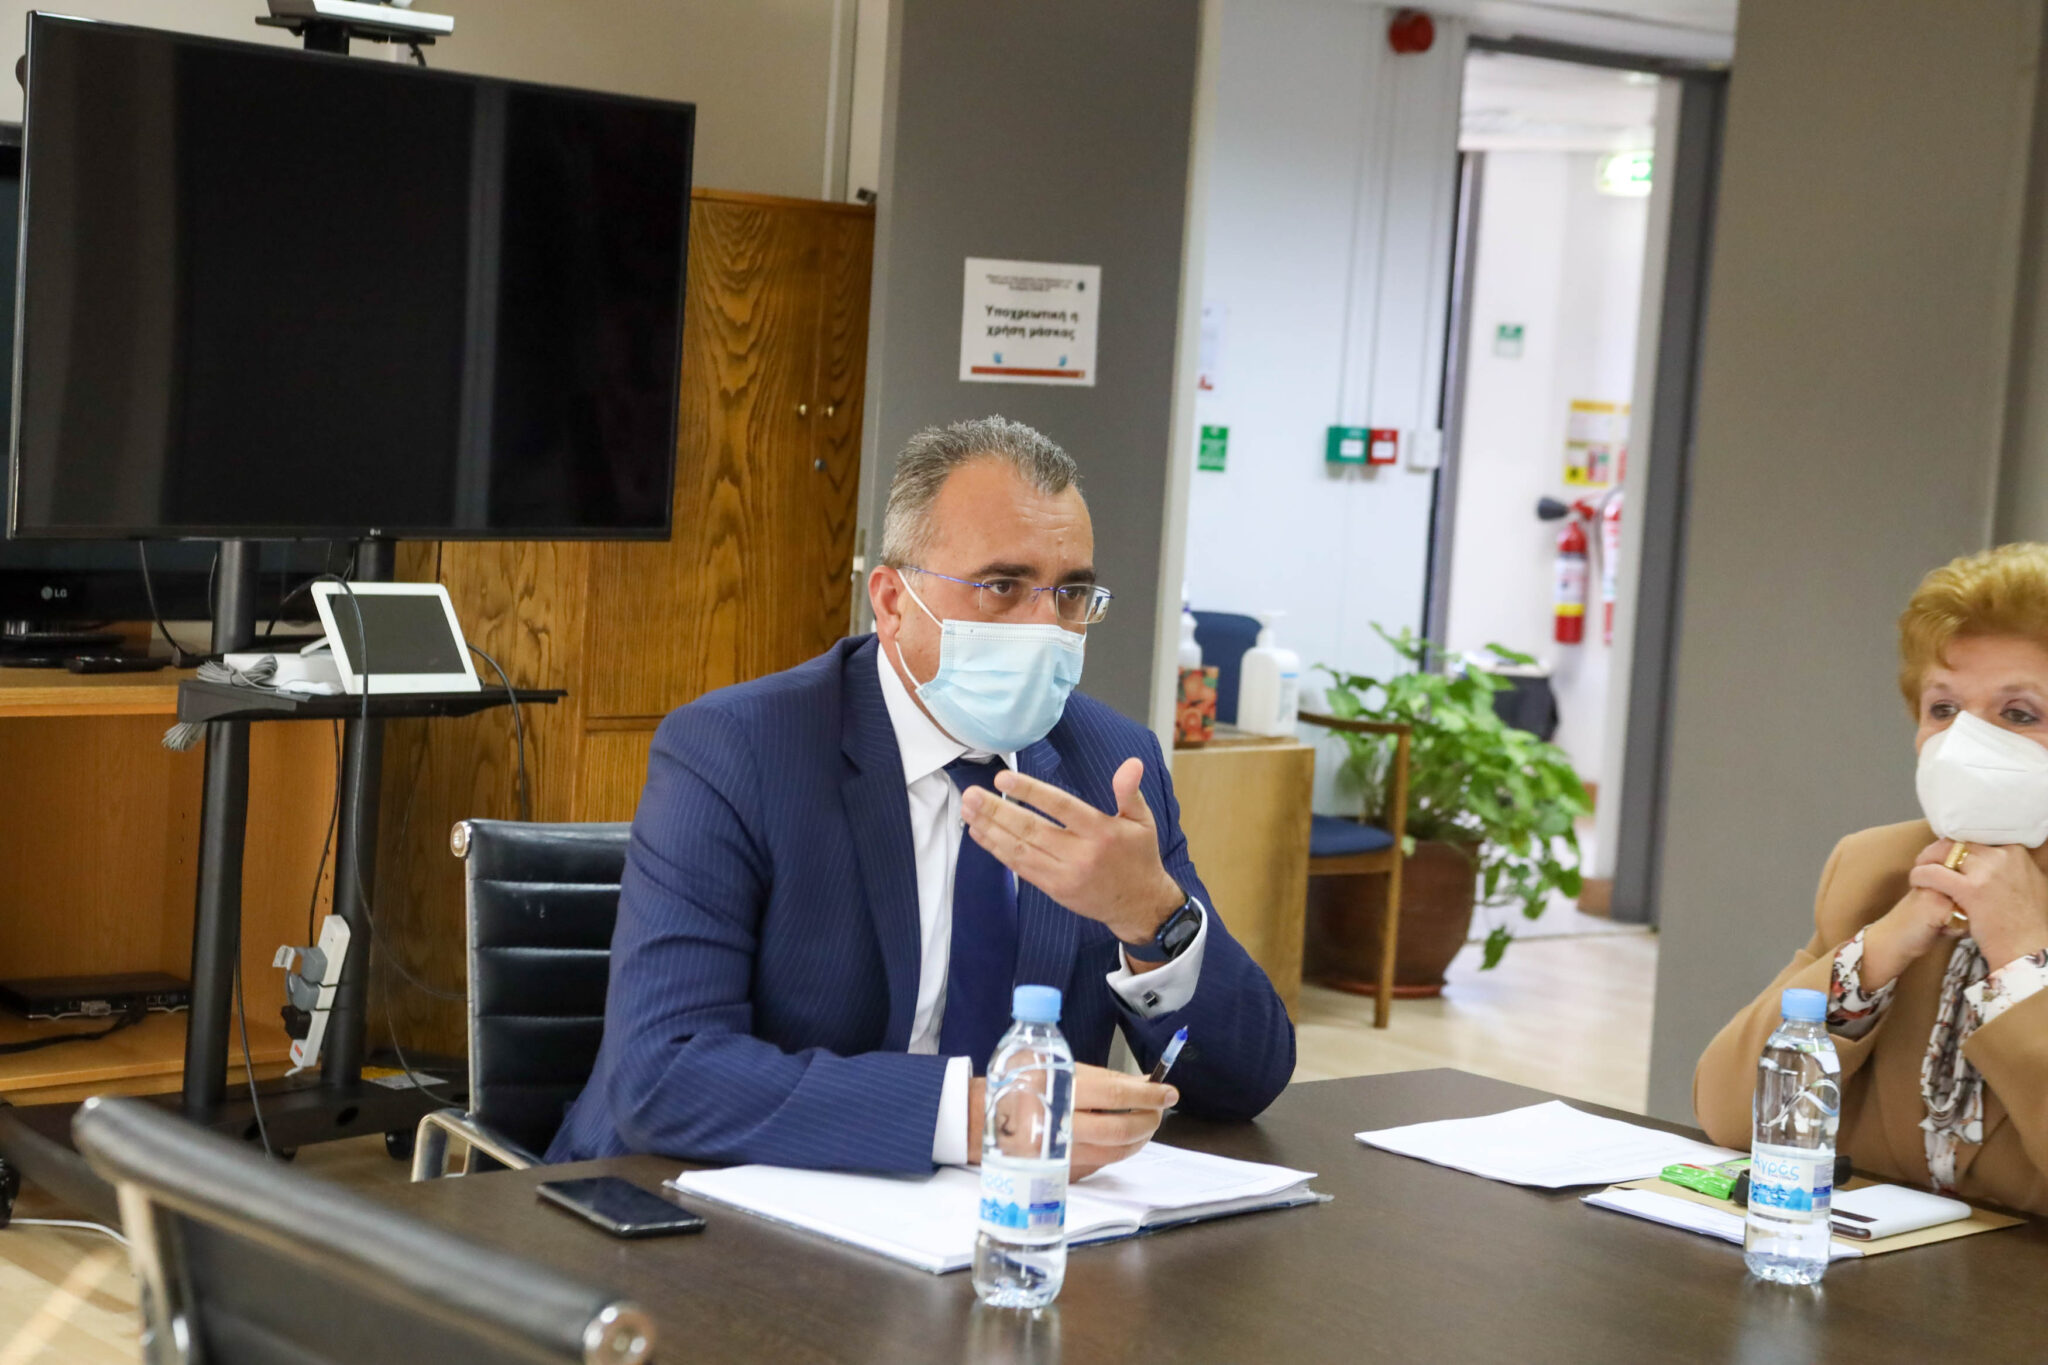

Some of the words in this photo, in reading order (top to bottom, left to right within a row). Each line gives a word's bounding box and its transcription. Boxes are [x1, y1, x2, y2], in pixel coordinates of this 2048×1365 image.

[985, 305, 1067, 322] Υποχρεωτική
[986, 324, 1026, 338] χρήση
[1029, 325, 1076, 341] μάσκας
